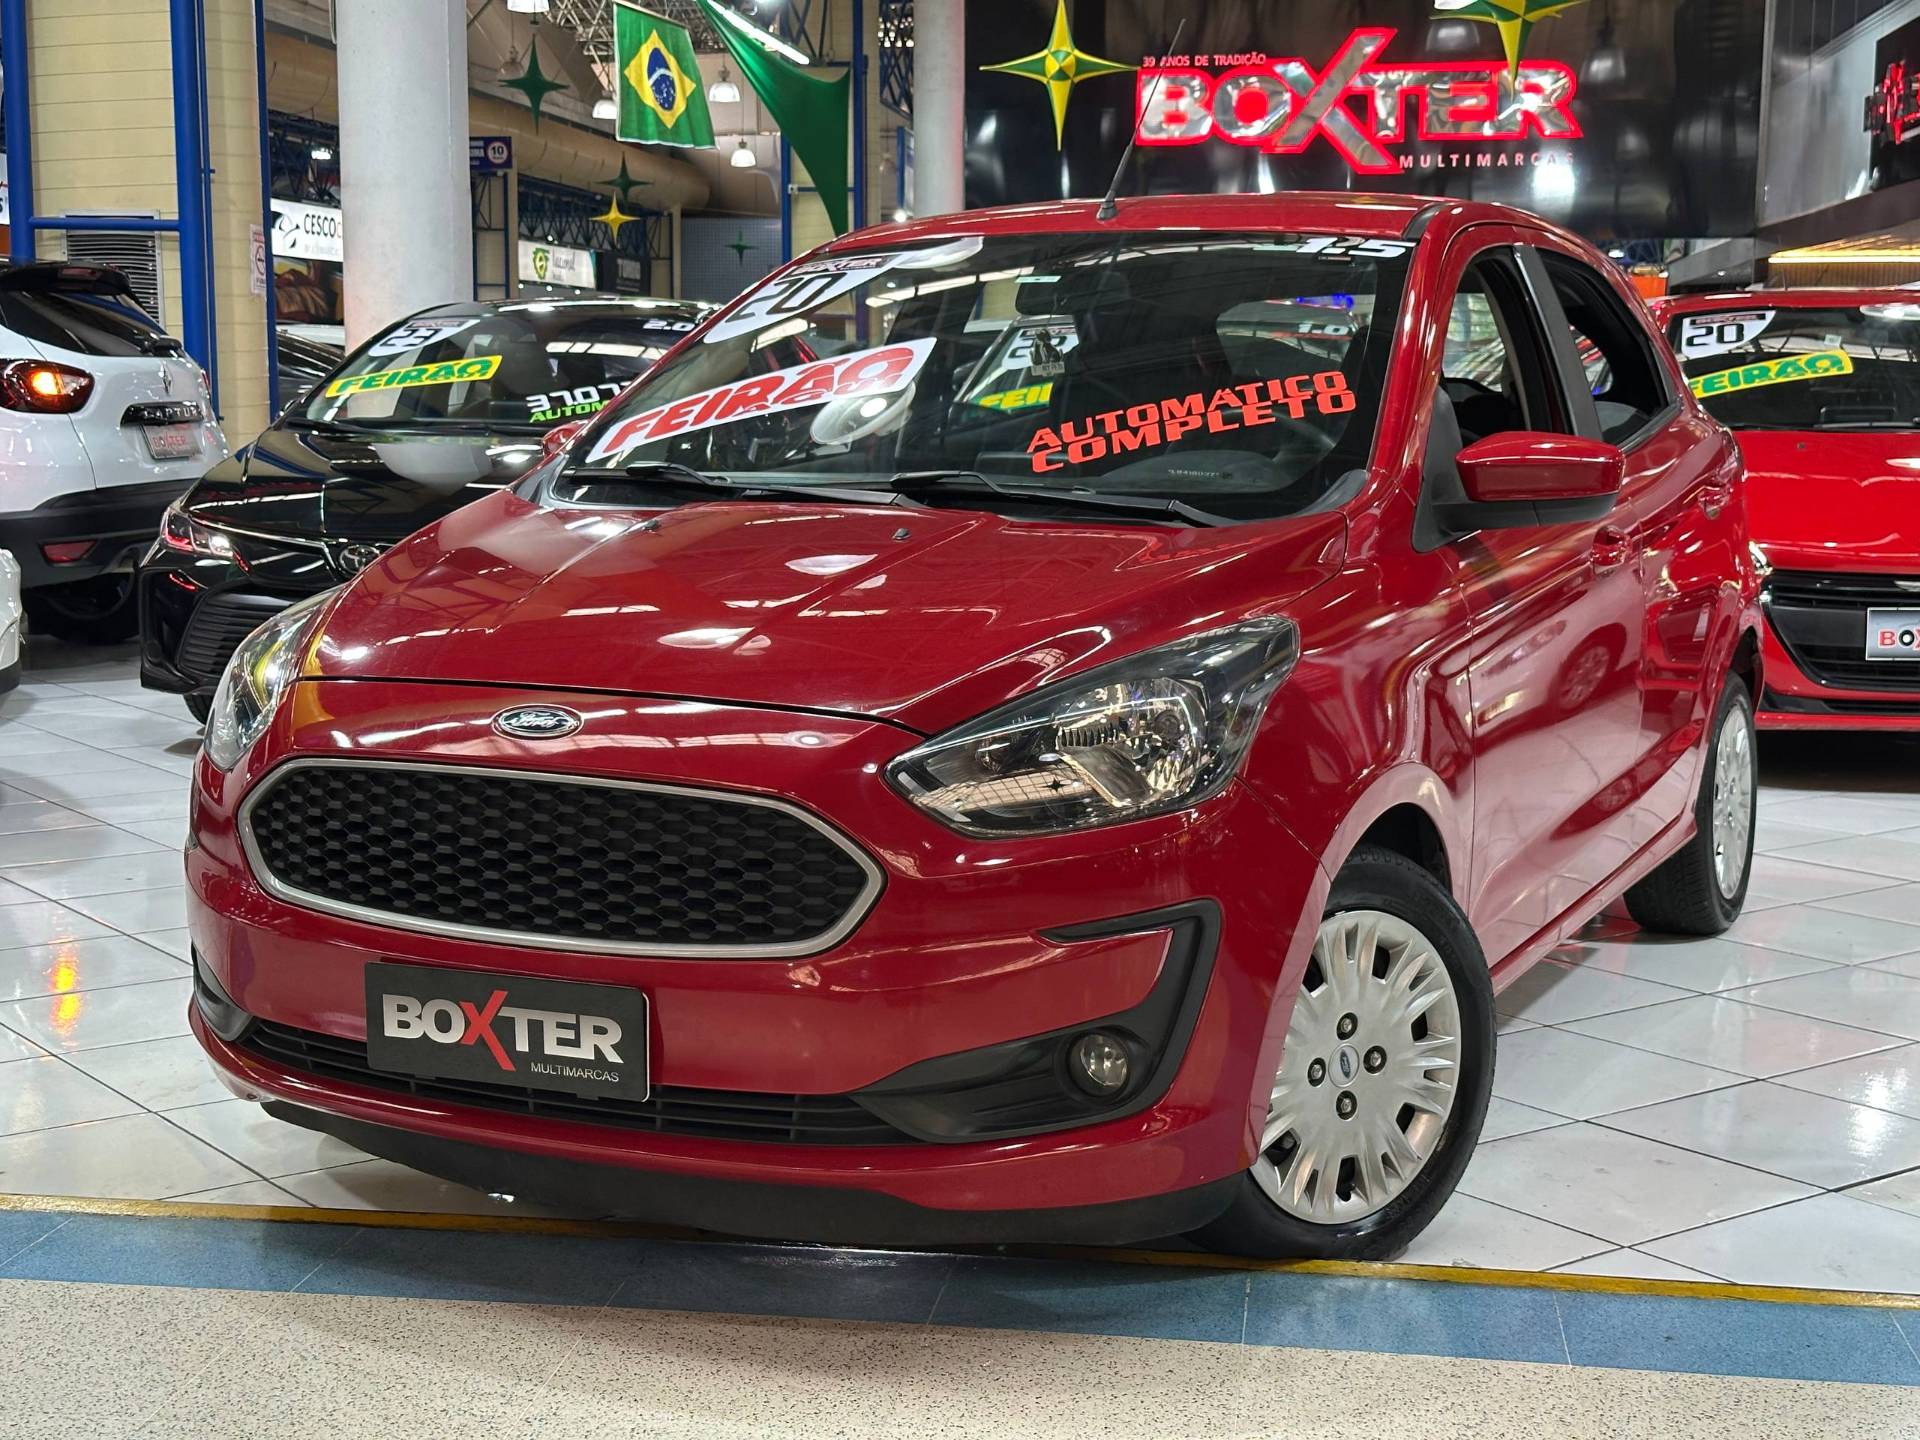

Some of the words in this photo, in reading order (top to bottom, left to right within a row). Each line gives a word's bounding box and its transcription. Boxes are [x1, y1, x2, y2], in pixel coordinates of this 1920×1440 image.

[1142, 56, 1155, 67] 39
[1160, 55, 1190, 67] ANOS
[1194, 55, 1209, 66] DE
[1213, 51, 1266, 67] TRADIÇÃO
[1136, 27, 1583, 174] BOXTER
[491, 144, 504, 156] 10
[1399, 151, 1575, 168] MULTIMARCAS
[643, 320, 696, 332] 2.0
[1685, 322, 1745, 347] 20
[526, 381, 631, 413] 37.07
[602, 347, 915, 453] FEIRÃO
[1027, 371, 1348, 453] AUTOMÁTICO
[1031, 389, 1356, 473] COMPLETO
[383, 990, 624, 1072] BOXTER
[531, 1062, 619, 1082] MULTIMARCAS
